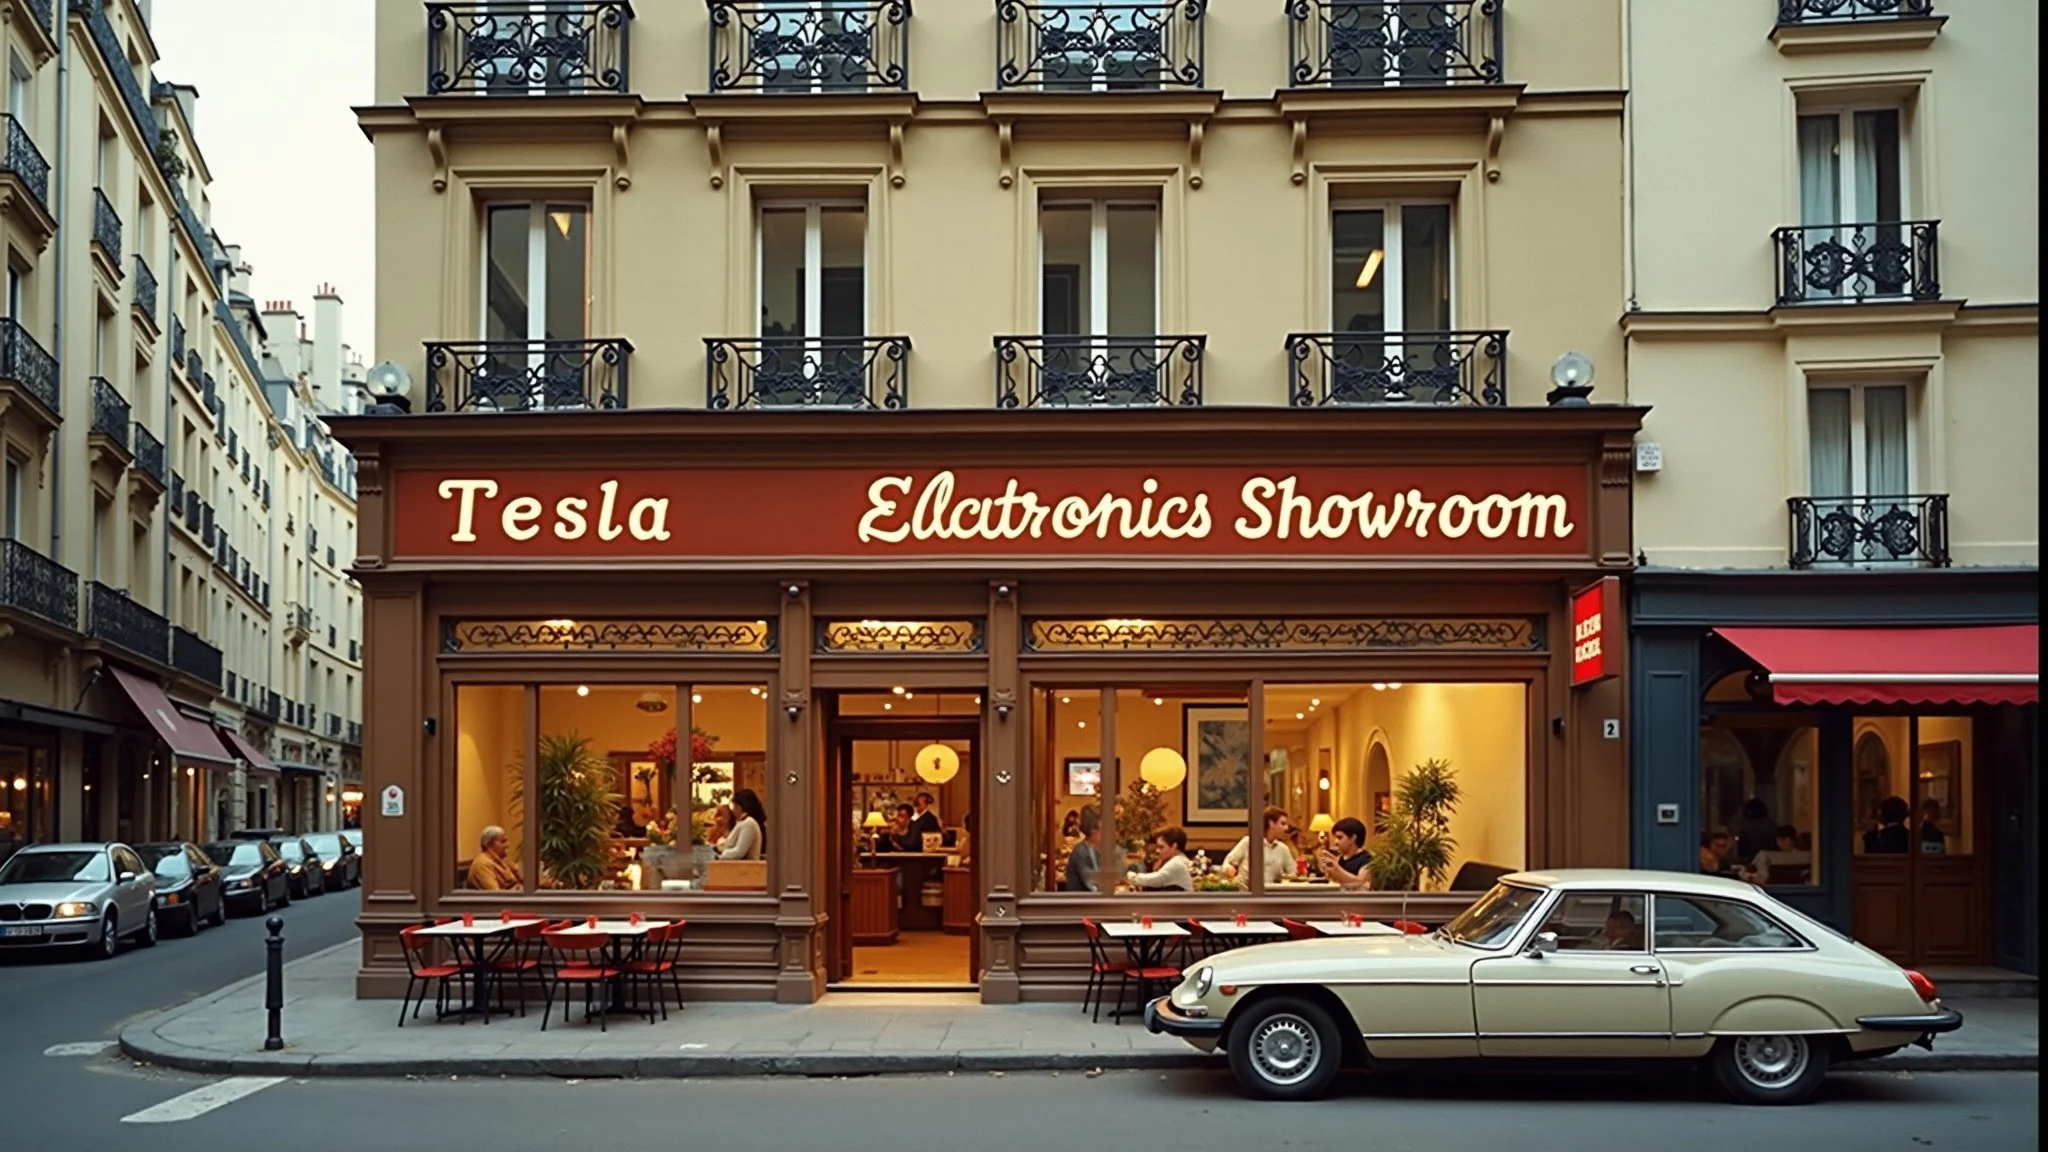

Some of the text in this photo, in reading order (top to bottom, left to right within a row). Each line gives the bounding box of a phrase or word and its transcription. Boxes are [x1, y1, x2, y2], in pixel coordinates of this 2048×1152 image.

[438, 479, 671, 542] Tesla
[1234, 475, 1574, 539] Showroom
[1607, 722, 1615, 736] 2
